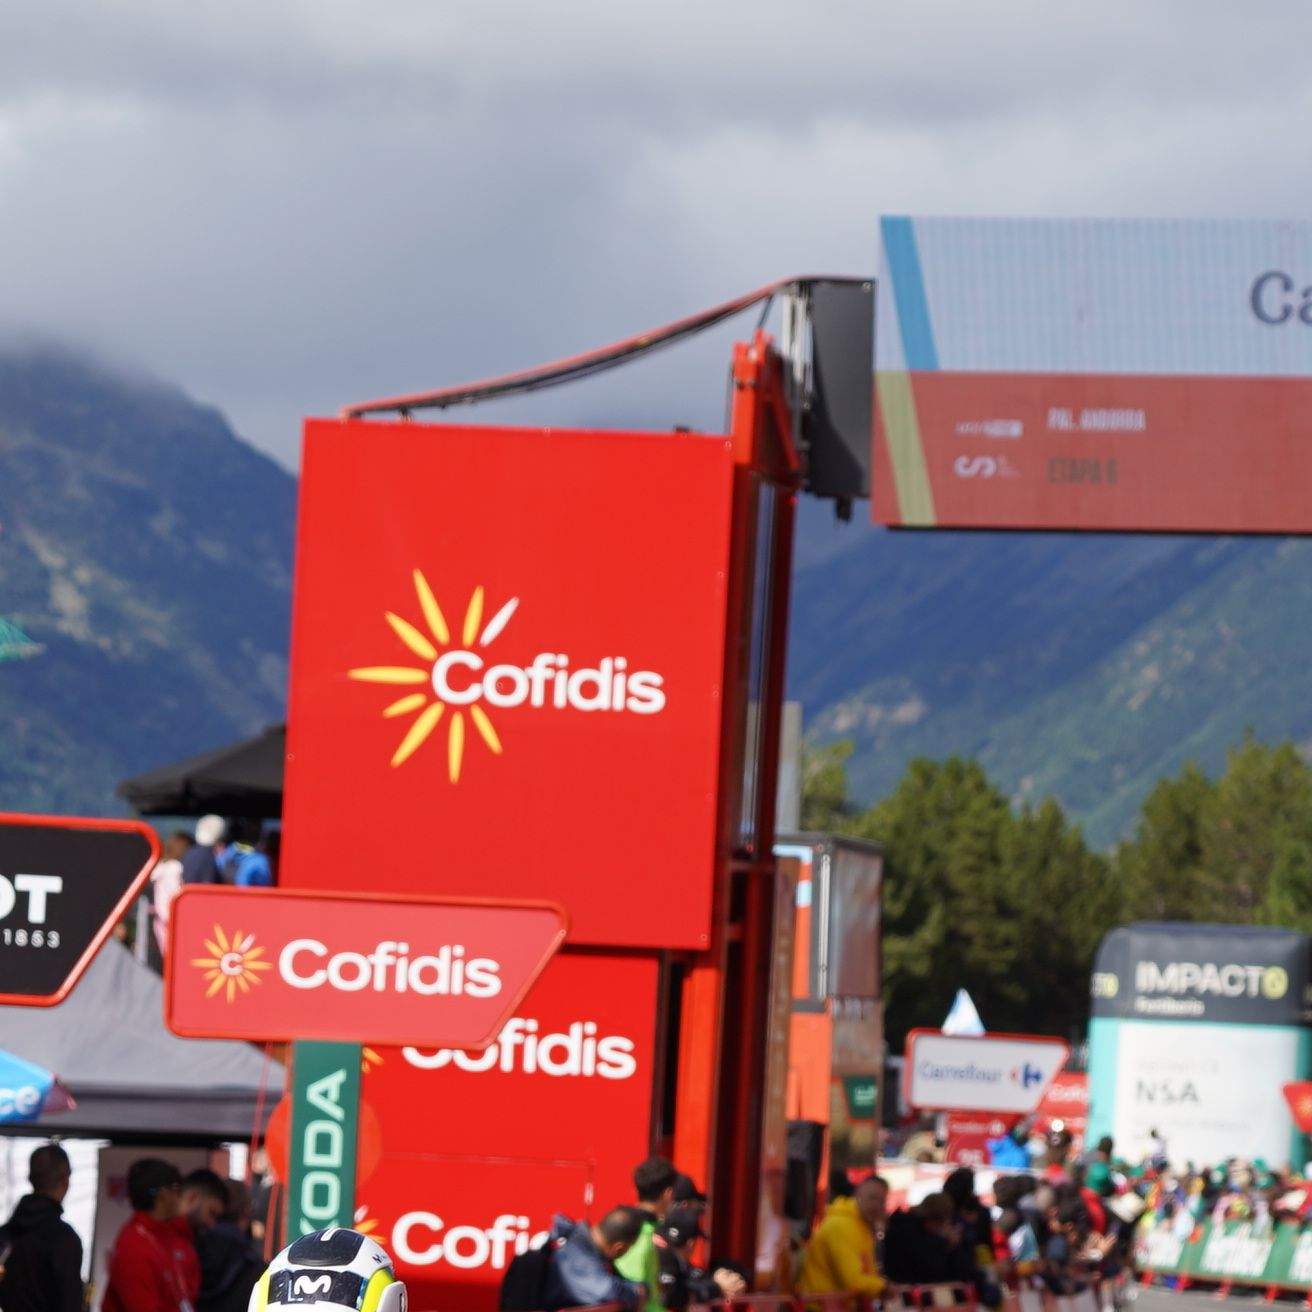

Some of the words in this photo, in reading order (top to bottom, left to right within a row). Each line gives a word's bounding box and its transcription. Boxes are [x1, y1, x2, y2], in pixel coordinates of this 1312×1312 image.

[431, 649, 666, 715] Cofidis
[3, 929, 61, 949] 1853
[278, 938, 502, 998] Cofidis
[391, 1211, 550, 1269] Cofi
